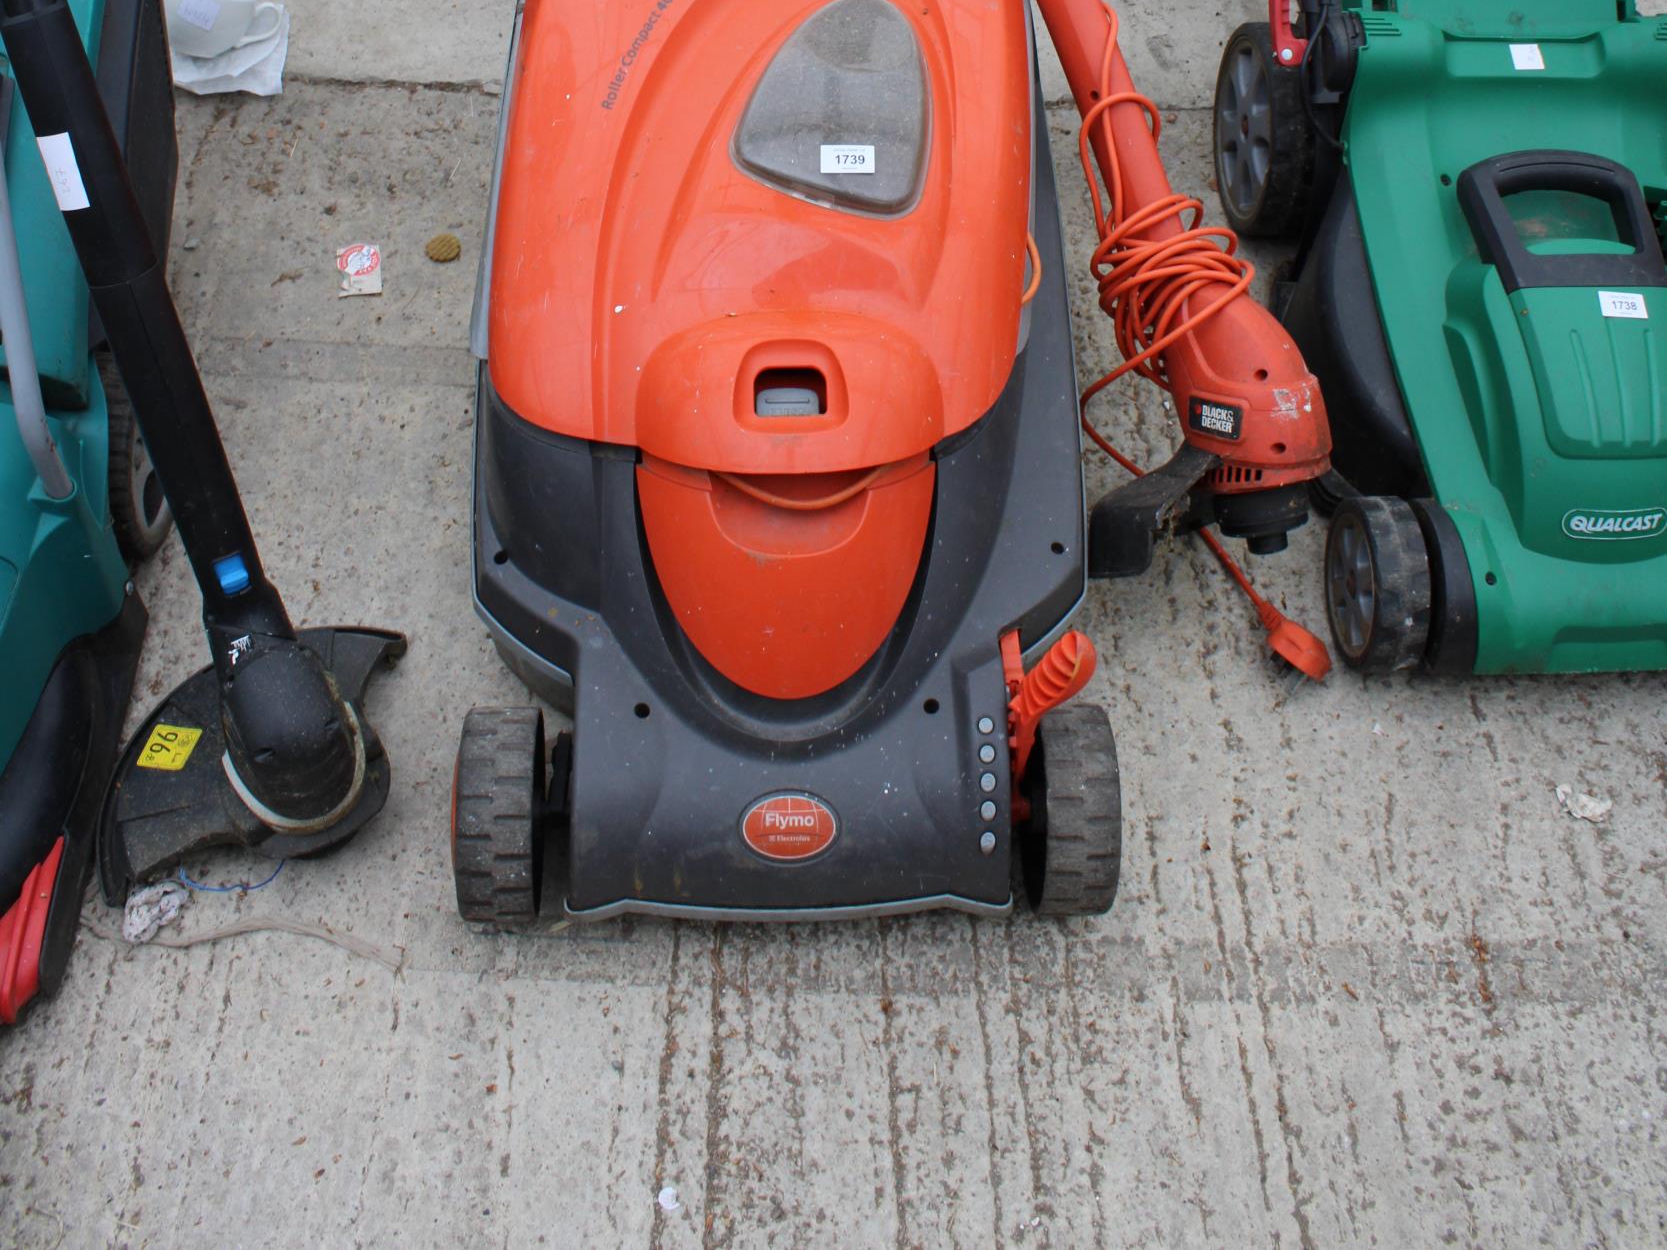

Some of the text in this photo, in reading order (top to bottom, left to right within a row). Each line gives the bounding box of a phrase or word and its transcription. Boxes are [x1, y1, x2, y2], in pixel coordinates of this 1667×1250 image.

[601, 66, 629, 111] Roller
[621, 11, 662, 67] Compact
[834, 154, 866, 165] 1739
[1611, 299, 1638, 311] 1738
[1201, 416, 1233, 433] DECKER
[1569, 513, 1663, 534] QUALCAST
[150, 731, 178, 753] 96
[765, 813, 815, 830] Flymo
[776, 834, 811, 843] Electrolux
